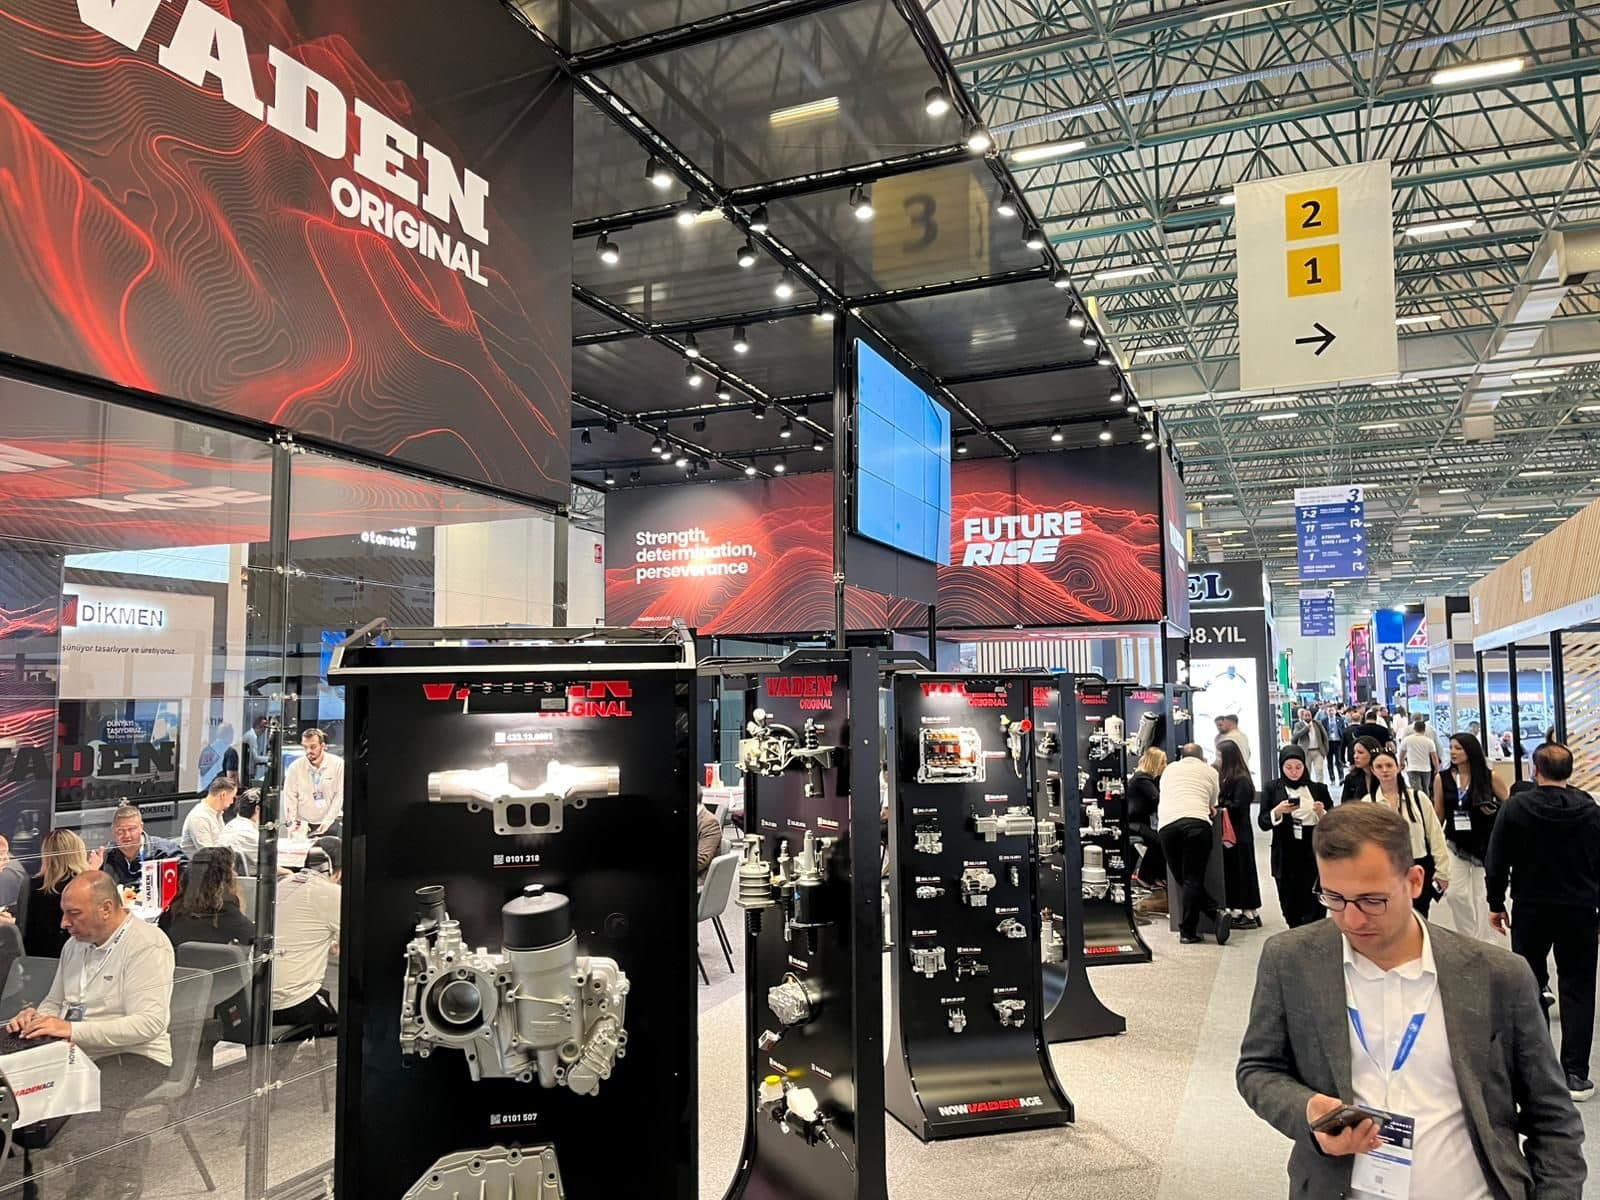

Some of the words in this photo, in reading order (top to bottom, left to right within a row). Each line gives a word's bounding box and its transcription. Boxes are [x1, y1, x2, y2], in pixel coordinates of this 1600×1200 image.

[1301, 200, 1322, 228] 2
[331, 176, 488, 287] ORIGINAL
[1304, 257, 1322, 284] 1
[1346, 488, 1359, 502] 3
[636, 527, 709, 547] Strength,
[963, 510, 1082, 542] FUTURE
[361, 531, 417, 550] otomotiv
[961, 536, 1060, 567] RISE
[636, 541, 757, 563] determination,
[636, 561, 748, 584] perseverance
[81, 602, 164, 627] DİKMEN
[766, 676, 832, 697] VADEN
[505, 855, 523, 863] 0101
[939, 1096, 1043, 1116] NOWVADENAGE
[502, 1114, 520, 1123] 0101
[522, 1113, 537, 1121] 507
